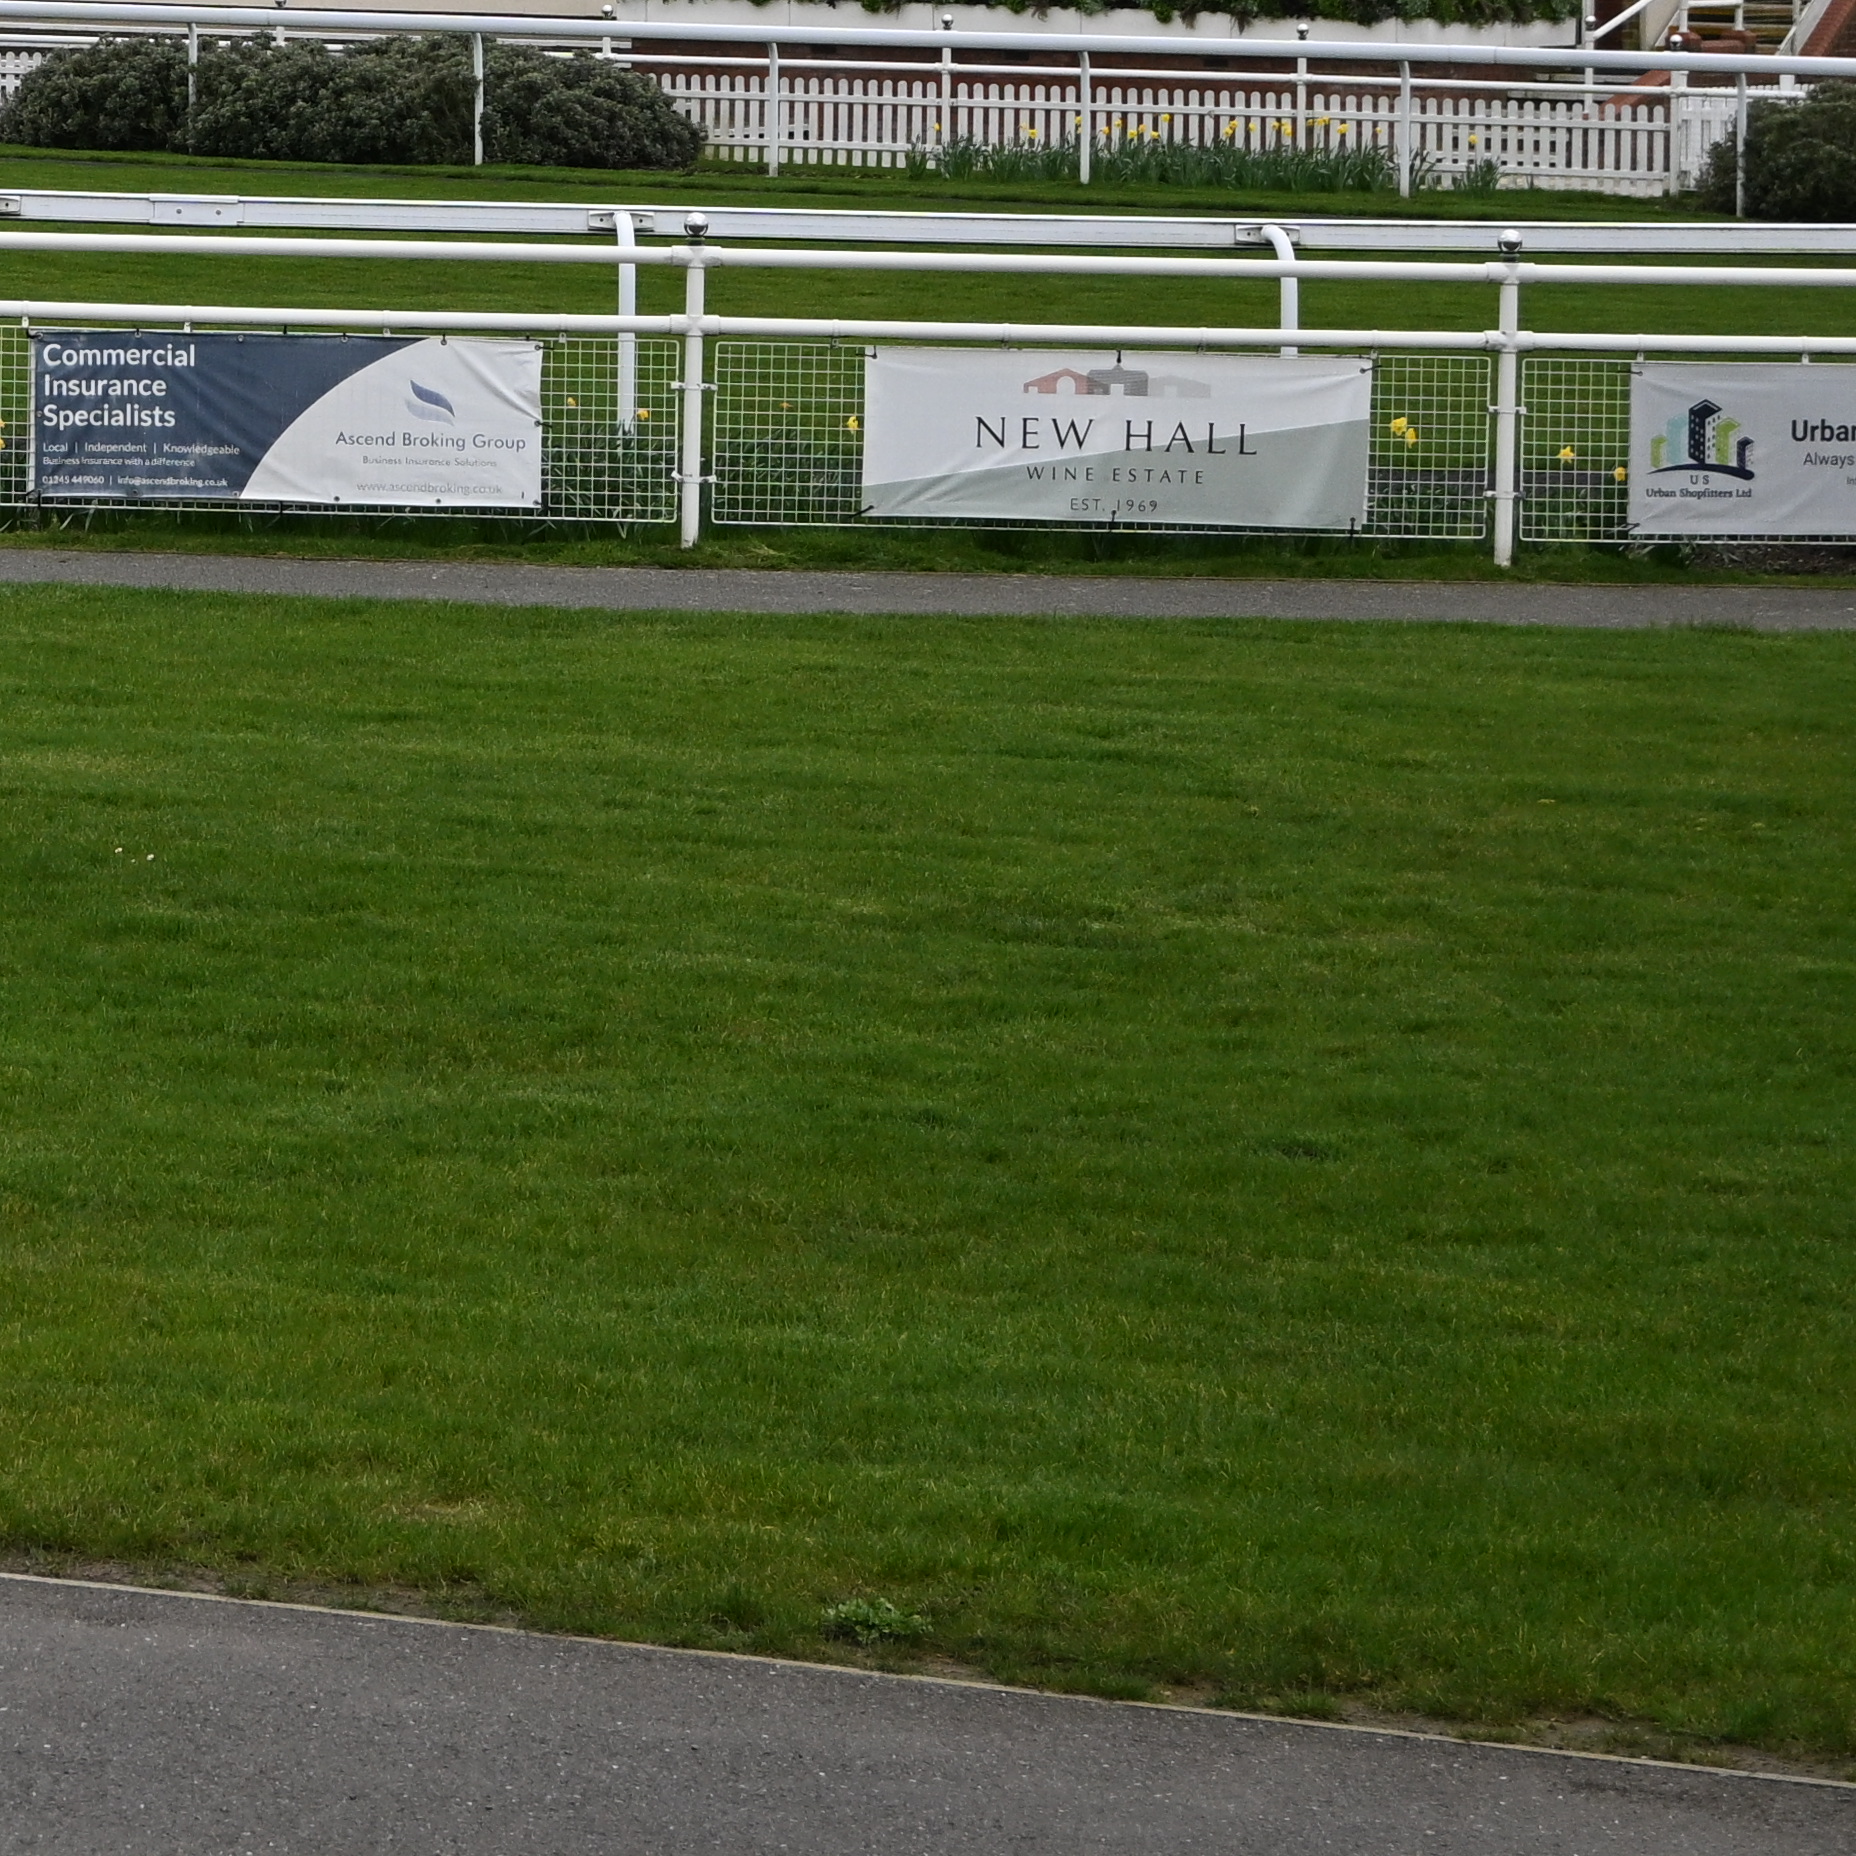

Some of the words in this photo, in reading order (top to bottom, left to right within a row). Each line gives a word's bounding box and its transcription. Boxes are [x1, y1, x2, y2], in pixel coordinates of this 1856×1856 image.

[43, 343, 196, 367] Commercial
[44, 374, 167, 397] Insurance
[43, 403, 176, 431] Specialists
[335, 431, 396, 446] Ascend
[402, 432, 466, 452] Broking
[472, 433, 526, 453] Group
[975, 416, 1094, 450] NEW
[1125, 419, 1258, 456] HALL
[43, 442, 68, 453] Local
[84, 442, 147, 454] Independent
[163, 443, 240, 456] Knowledgeable
[43, 456, 80, 465] Business
[124, 457, 143, 466] with
[362, 456, 402, 465] Business
[405, 456, 451, 467] Insurance
[454, 458, 498, 467] Solutions
[1803, 451, 1855, 469] Always
[1026, 466, 1094, 482] WINE
[1112, 468, 1205, 485] ESTATE
[356, 481, 503, 496] www.ascendbroking.co.uk
[1646, 488, 1677, 498] Urban
[1679, 488, 1733, 500] Shopfitters
[1736, 488, 1752, 498] Ltd
[1070, 498, 1106, 512] EST.
[1116, 499, 1158, 512] 1969
